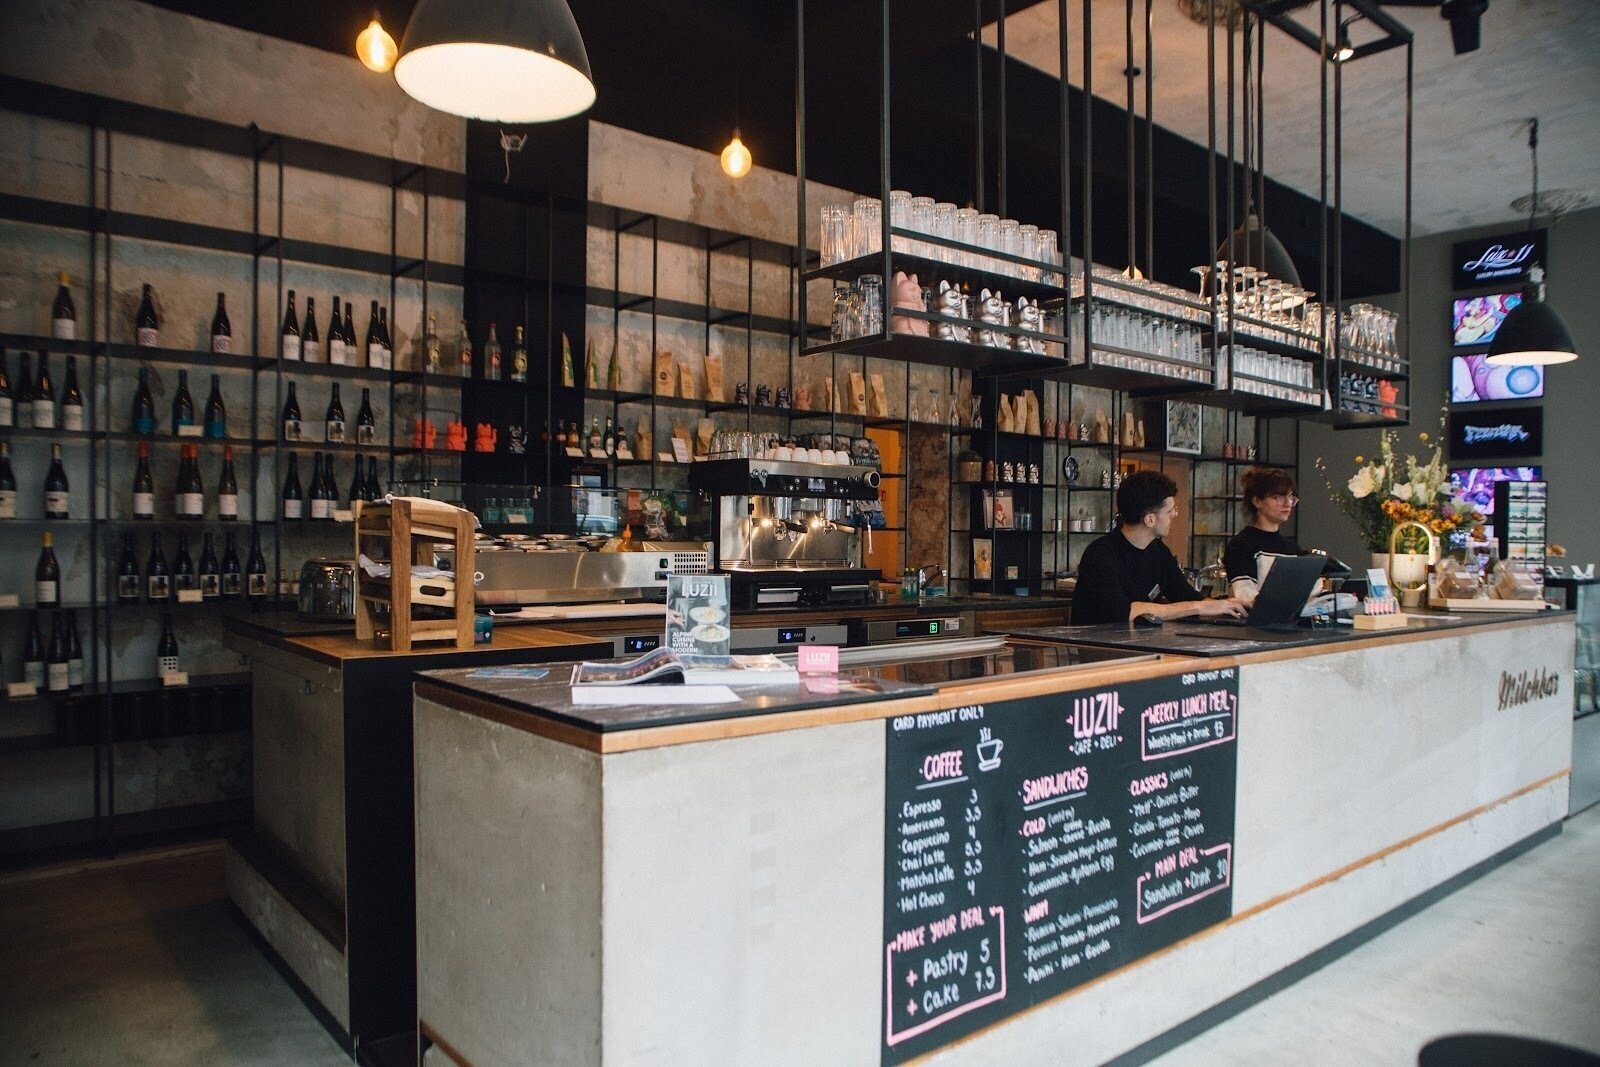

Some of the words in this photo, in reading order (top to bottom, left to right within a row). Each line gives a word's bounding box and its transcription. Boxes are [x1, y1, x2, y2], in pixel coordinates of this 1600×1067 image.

[682, 583, 717, 597] LUZII
[893, 716, 914, 731] CARD
[917, 709, 957, 728] PAYMENT
[959, 705, 984, 721] ONLY
[1074, 691, 1118, 739] LUZII
[1148, 700, 1178, 724] WEEKLY
[1181, 693, 1207, 718] LUNCH
[1100, 735, 1117, 750] DELI
[1193, 726, 1210, 739] Drink
[924, 750, 963, 781] COFFEE
[1023, 766, 1089, 805] SANDWICHES
[1130, 771, 1168, 796] CLASSICS
[1179, 785, 1199, 803] Butter
[903, 798, 941, 819] Espresso
[969, 788, 978, 804] 3
[902, 816, 945, 835] Americano
[1023, 816, 1046, 837] COLD
[1087, 816, 1111, 836] Rucola
[1133, 820, 1156, 837] Gouda
[1156, 812, 1181, 829] Tomato
[1183, 806, 1201, 822] Mayo
[902, 831, 950, 855] Cappuccino
[968, 825, 976, 839] 4
[1028, 837, 1058, 858] Salmon
[902, 856, 922, 872] Chai
[1028, 861, 1046, 877] Ham
[1155, 853, 1176, 878] MAIN
[1179, 846, 1199, 869] DEAL
[901, 871, 934, 892] Matcha
[1028, 871, 1069, 897] Guacamole
[1142, 878, 1183, 910] Sandwich
[1190, 866, 1211, 890] Drink
[901, 894, 917, 913] Hot
[919, 891, 945, 908] Choco
[967, 879, 975, 897] 4
[1024, 898, 1049, 924] WARM
[897, 925, 925, 952] MAKE
[930, 914, 957, 943] YOUR
[960, 905, 985, 931] DEAL
[923, 949, 968, 982] Pastry
[979, 937, 990, 964] 5
[1028, 961, 1054, 985] Panini
[1061, 953, 1080, 971] Ham
[1085, 938, 1111, 960] Gouda
[923, 983, 960, 1014] Cake
